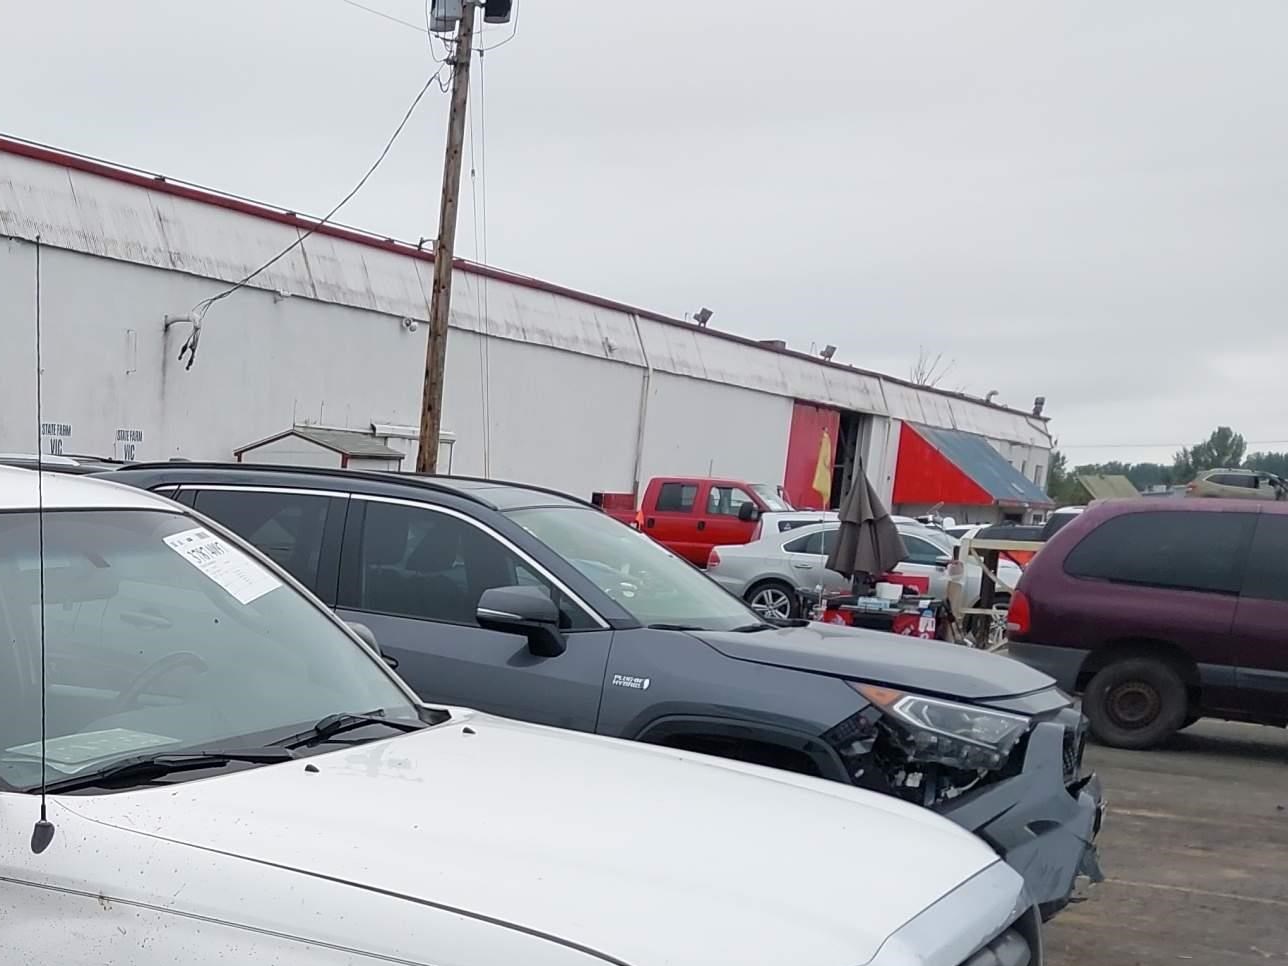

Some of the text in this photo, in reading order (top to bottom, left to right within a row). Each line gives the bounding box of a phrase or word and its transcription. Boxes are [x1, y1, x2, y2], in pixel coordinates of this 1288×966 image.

[41, 423, 72, 437] STATE FARM
[116, 429, 143, 442] STATE FARM
[50, 438, 63, 455] VIC
[123, 444, 136, 461] VIC
